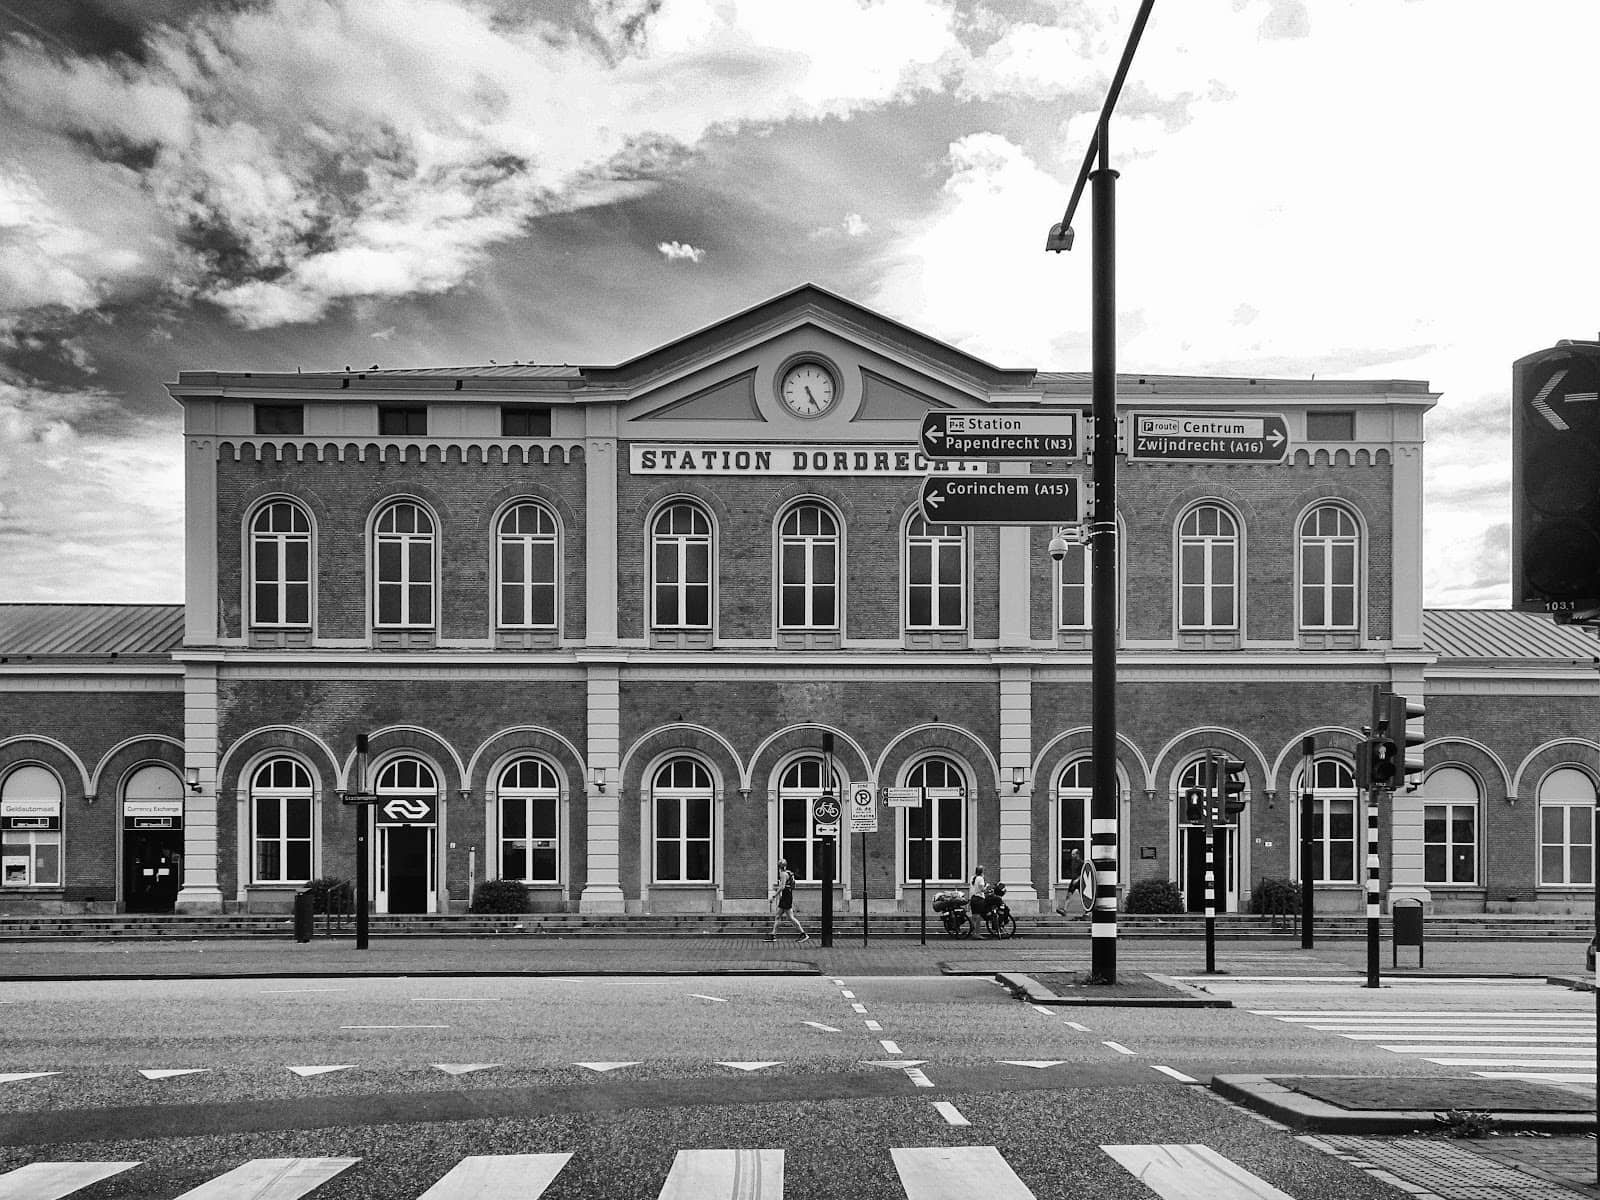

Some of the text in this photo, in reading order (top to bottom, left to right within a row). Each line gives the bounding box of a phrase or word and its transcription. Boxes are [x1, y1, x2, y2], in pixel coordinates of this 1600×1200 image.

[968, 418, 1022, 430] Station
[1155, 422, 1177, 430] route
[1183, 421, 1245, 434] Centrum
[946, 437, 1073, 452] Papendrecht (N3)
[1137, 437, 1264, 454] Zwijndrecht (A16)
[641, 450, 772, 470] STATION
[946, 482, 1069, 496] Gorinchem (A15)
[1545, 601, 1575, 611] 103.1
